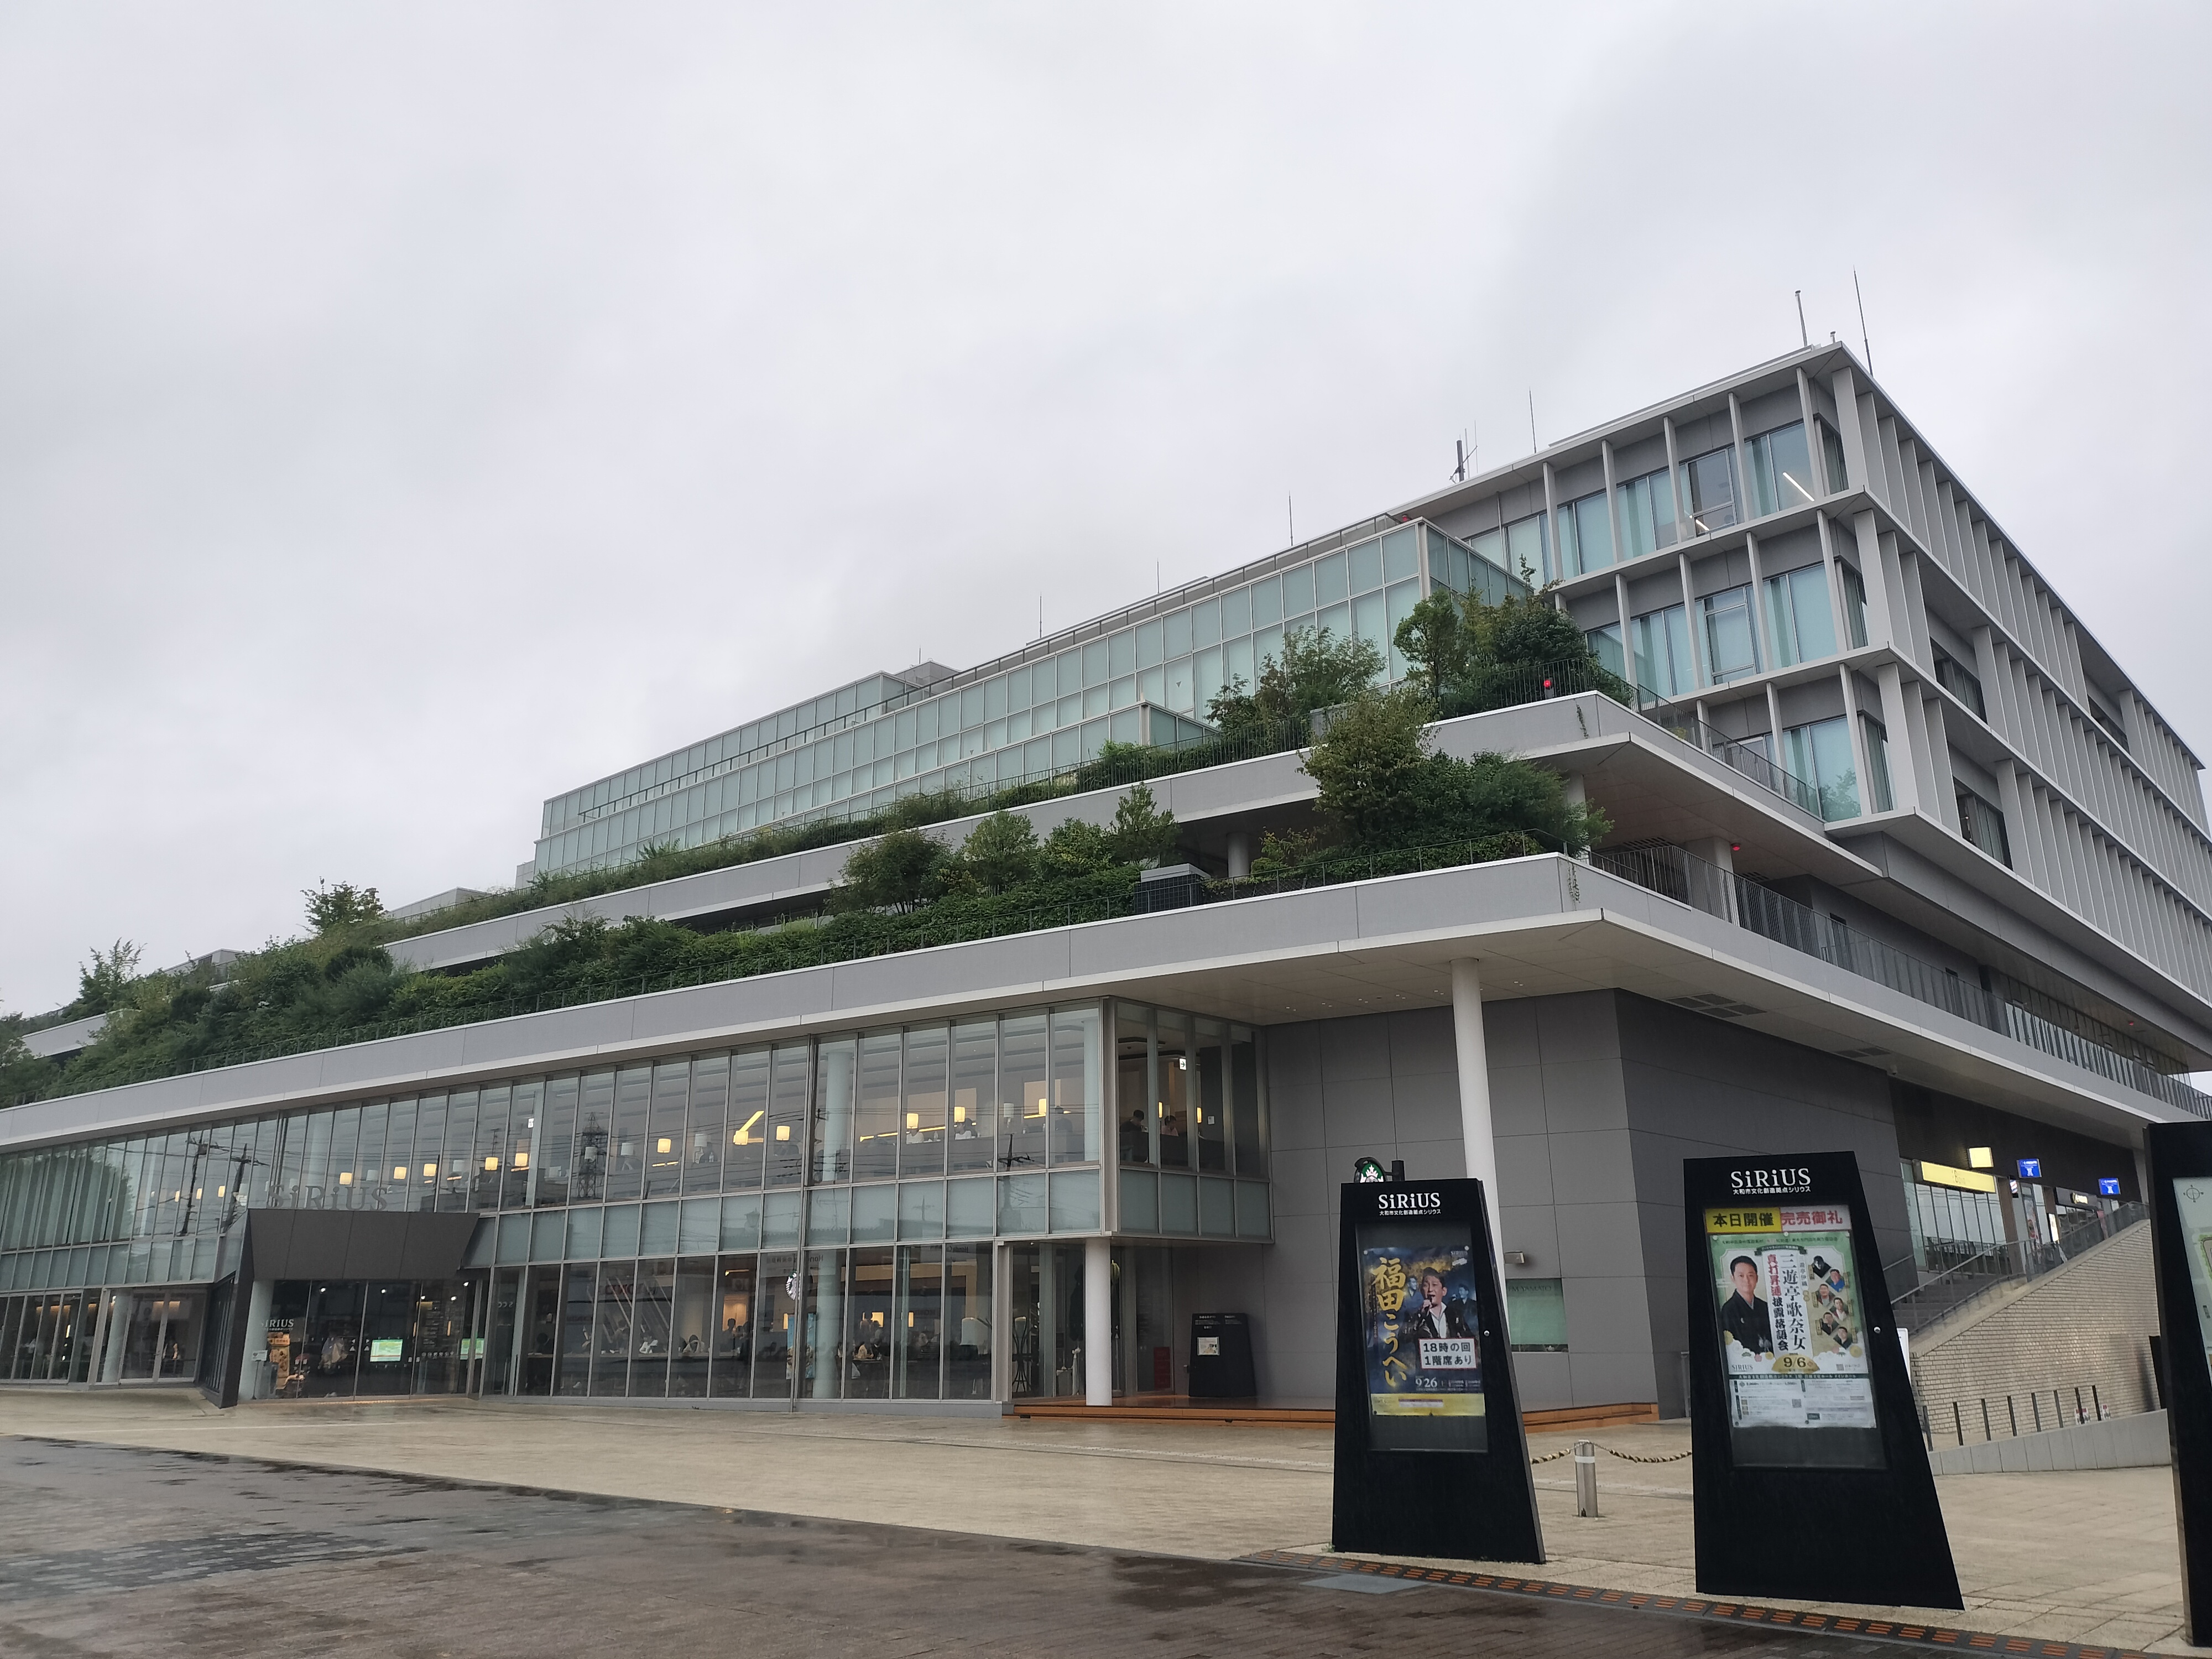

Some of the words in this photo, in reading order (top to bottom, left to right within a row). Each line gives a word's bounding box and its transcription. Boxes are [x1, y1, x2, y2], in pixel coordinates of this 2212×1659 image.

[1731, 1168, 1811, 1188] SiRiUS
[265, 1184, 389, 1211] SiRiUS
[1379, 1193, 1441, 1209] SiRiUS
[1713, 1213, 1774, 1227] 本日開催
[1781, 1210, 1843, 1225] 完売御礼
[1371, 1257, 1407, 1387] 福田こうへい
[1423, 1342, 1470, 1353] 18時の回
[1425, 1355, 1472, 1366] 1階席あり
[1783, 1357, 1806, 1368] 9/6
